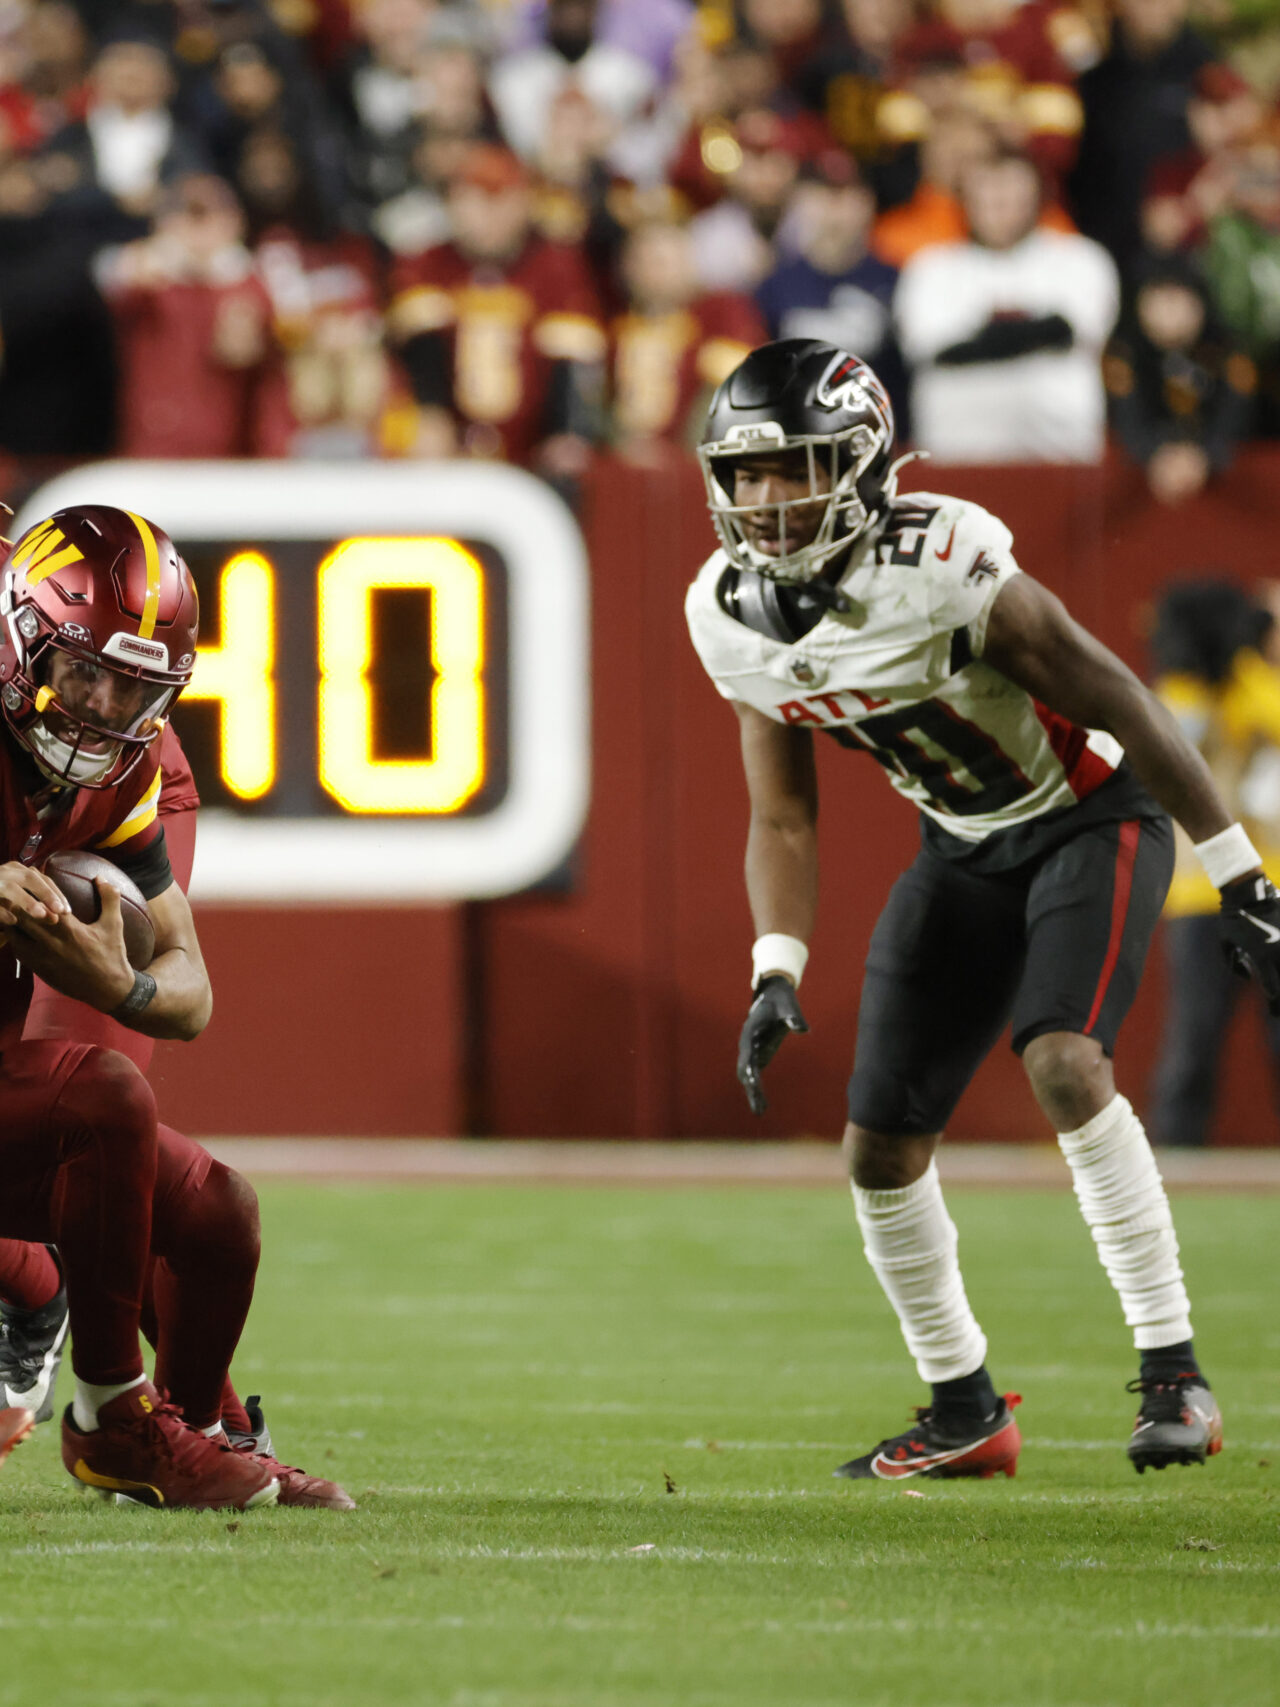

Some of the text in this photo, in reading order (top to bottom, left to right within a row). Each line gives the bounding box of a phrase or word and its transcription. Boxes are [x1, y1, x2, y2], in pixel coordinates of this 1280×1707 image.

[120, 639, 164, 659] COMMANDERS
[775, 689, 891, 727] ATL
[138, 1394, 153, 1414] 5
